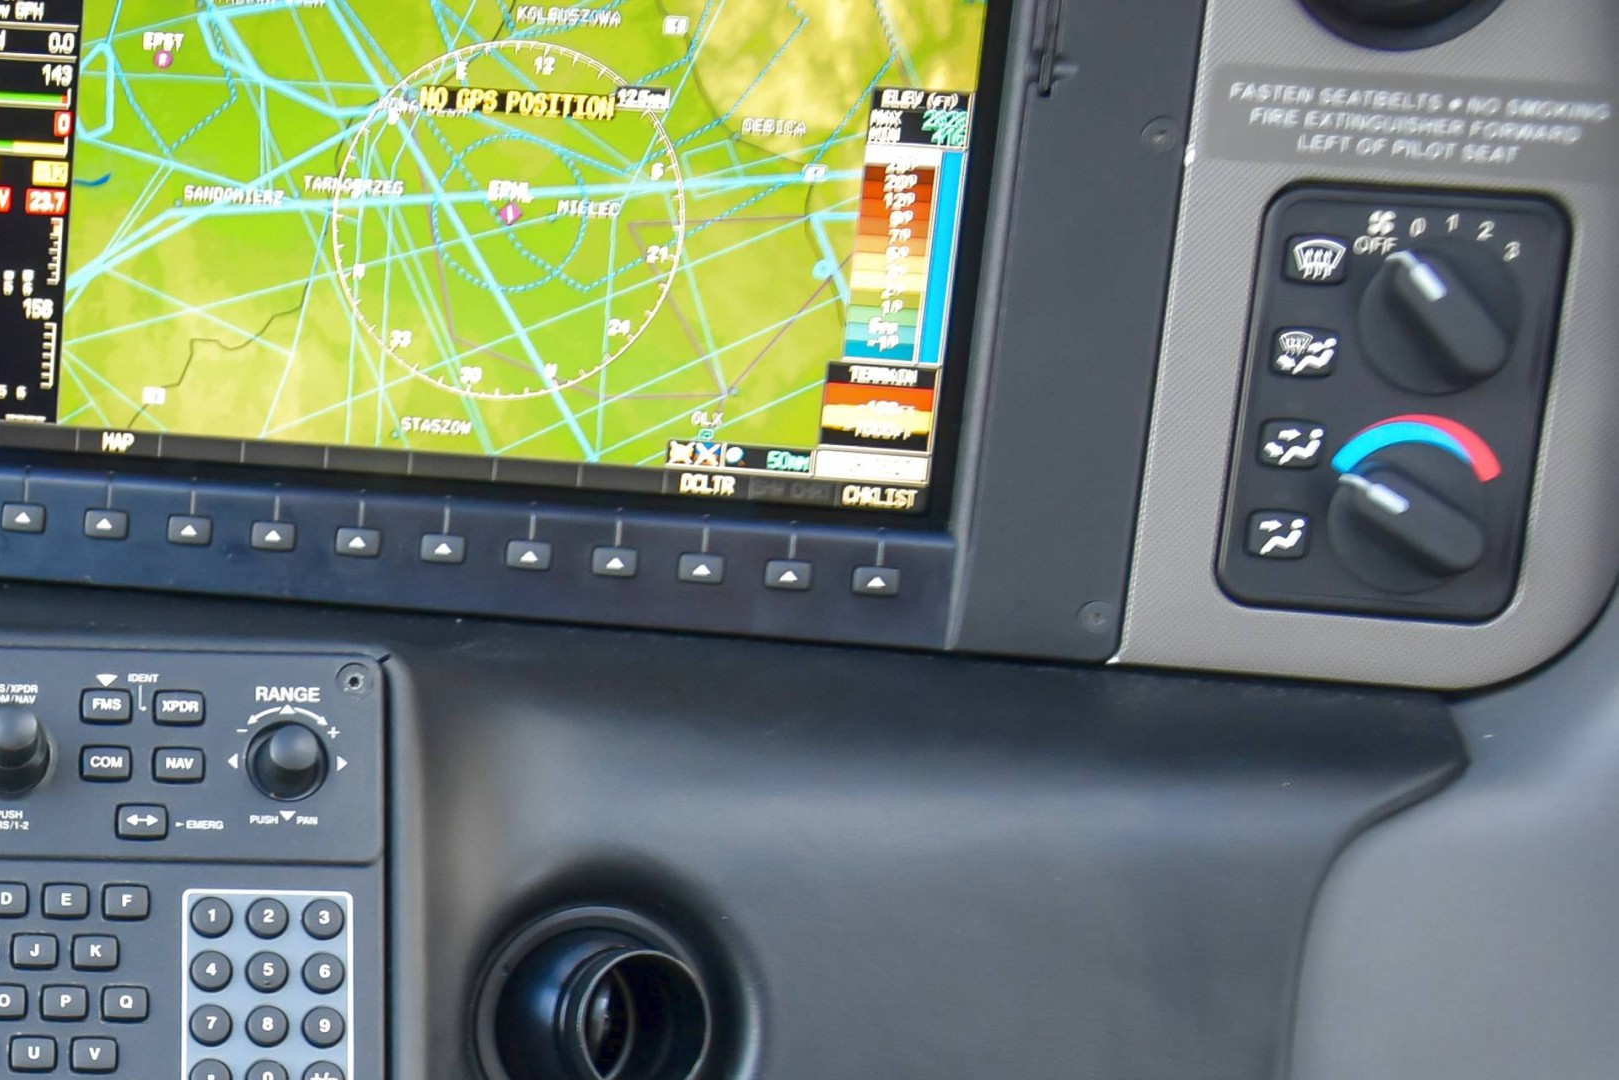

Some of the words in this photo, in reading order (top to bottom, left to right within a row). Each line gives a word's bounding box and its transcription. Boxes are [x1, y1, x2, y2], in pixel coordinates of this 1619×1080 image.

[42, 64, 73, 86] 143
[420, 87, 448, 107] NO
[456, 88, 498, 112] GPS
[505, 91, 615, 119] POSITION
[1229, 82, 1314, 103] FASTEN
[1319, 88, 1443, 112] SEATBELTS
[1466, 98, 1501, 115] NO
[1249, 107, 1299, 127] FIRE
[1304, 110, 1465, 135] EXTINGUISHER
[1469, 120, 1582, 145] FORWARD
[1296, 134, 1349, 153] LEFT
[1355, 138, 1388, 156] OF
[1391, 139, 1457, 161] PILOT
[1460, 145, 1520, 164] SEAT
[1409, 217, 1427, 238] 0
[1476, 221, 1495, 242] 2
[1353, 237, 1399, 255] OFF
[1503, 241, 1521, 262] 3
[679, 474, 736, 496] DCLTR
[842, 485, 919, 510] CHKLIST
[92, 699, 122, 711] FMS
[255, 686, 321, 703] RANGE
[162, 701, 199, 713] XPDR
[90, 756, 123, 768] COM
[166, 758, 194, 770] NAV
